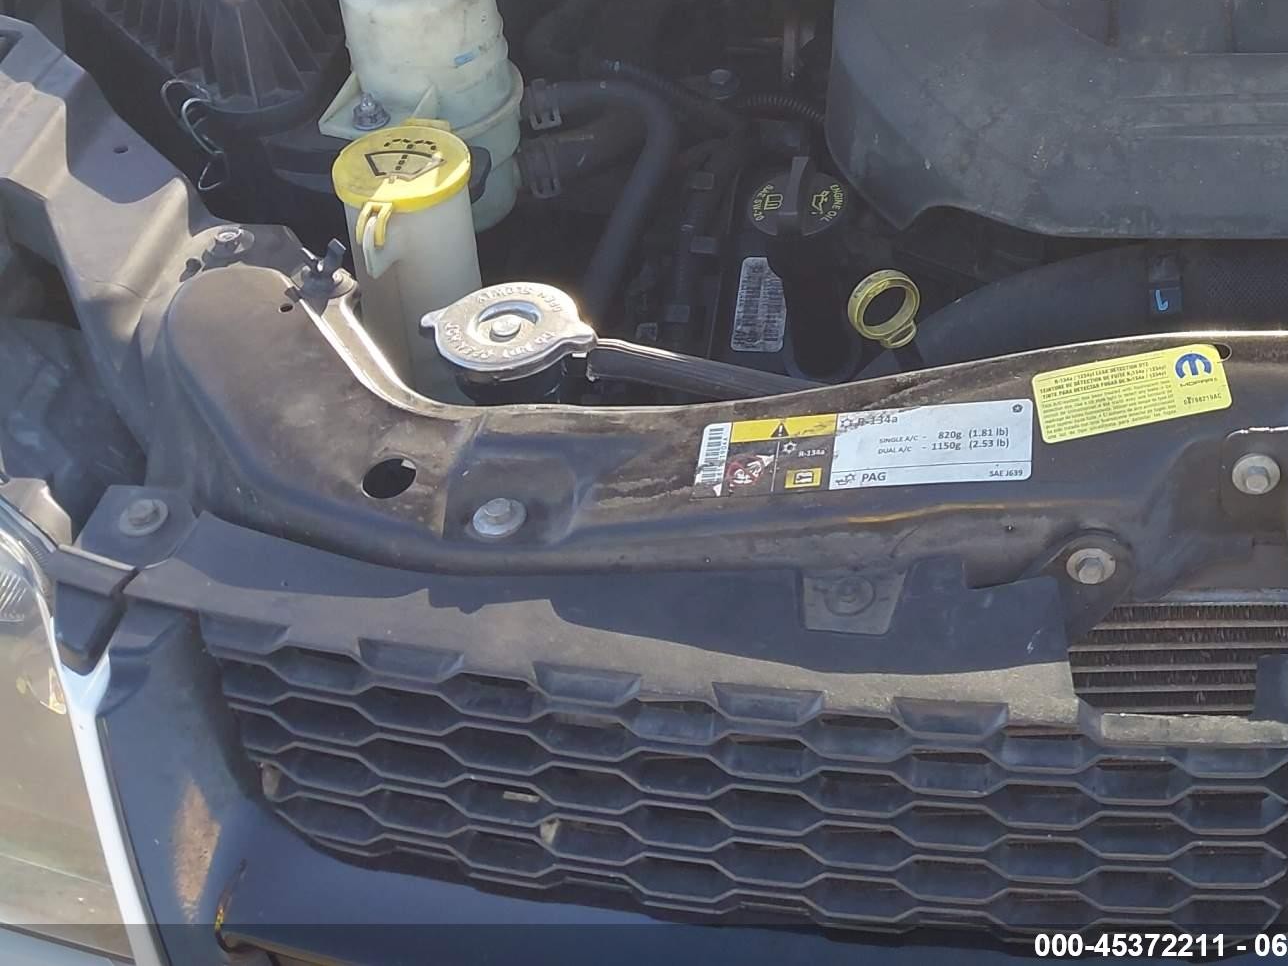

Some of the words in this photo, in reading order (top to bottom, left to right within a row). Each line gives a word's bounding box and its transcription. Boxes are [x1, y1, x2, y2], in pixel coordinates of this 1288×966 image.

[830, 184, 844, 210] ENGINE
[820, 210, 837, 222] OIL
[1110, 365, 1137, 374] DETECTION
[879, 436, 904, 444] SINGLE
[905, 434, 919, 442] A/C
[938, 430, 962, 440] 820g
[968, 428, 993, 438] (1.81
[996, 427, 1009, 437] lb)
[878, 445, 898, 454] DUAL
[898, 445, 912, 454] A/C
[931, 441, 961, 451] 1150g
[968, 439, 994, 449] (2.53
[996, 438, 1010, 449] lb)
[861, 471, 887, 483] PAG
[989, 469, 1004, 477] SAE
[1004, 468, 1023, 477] J639
